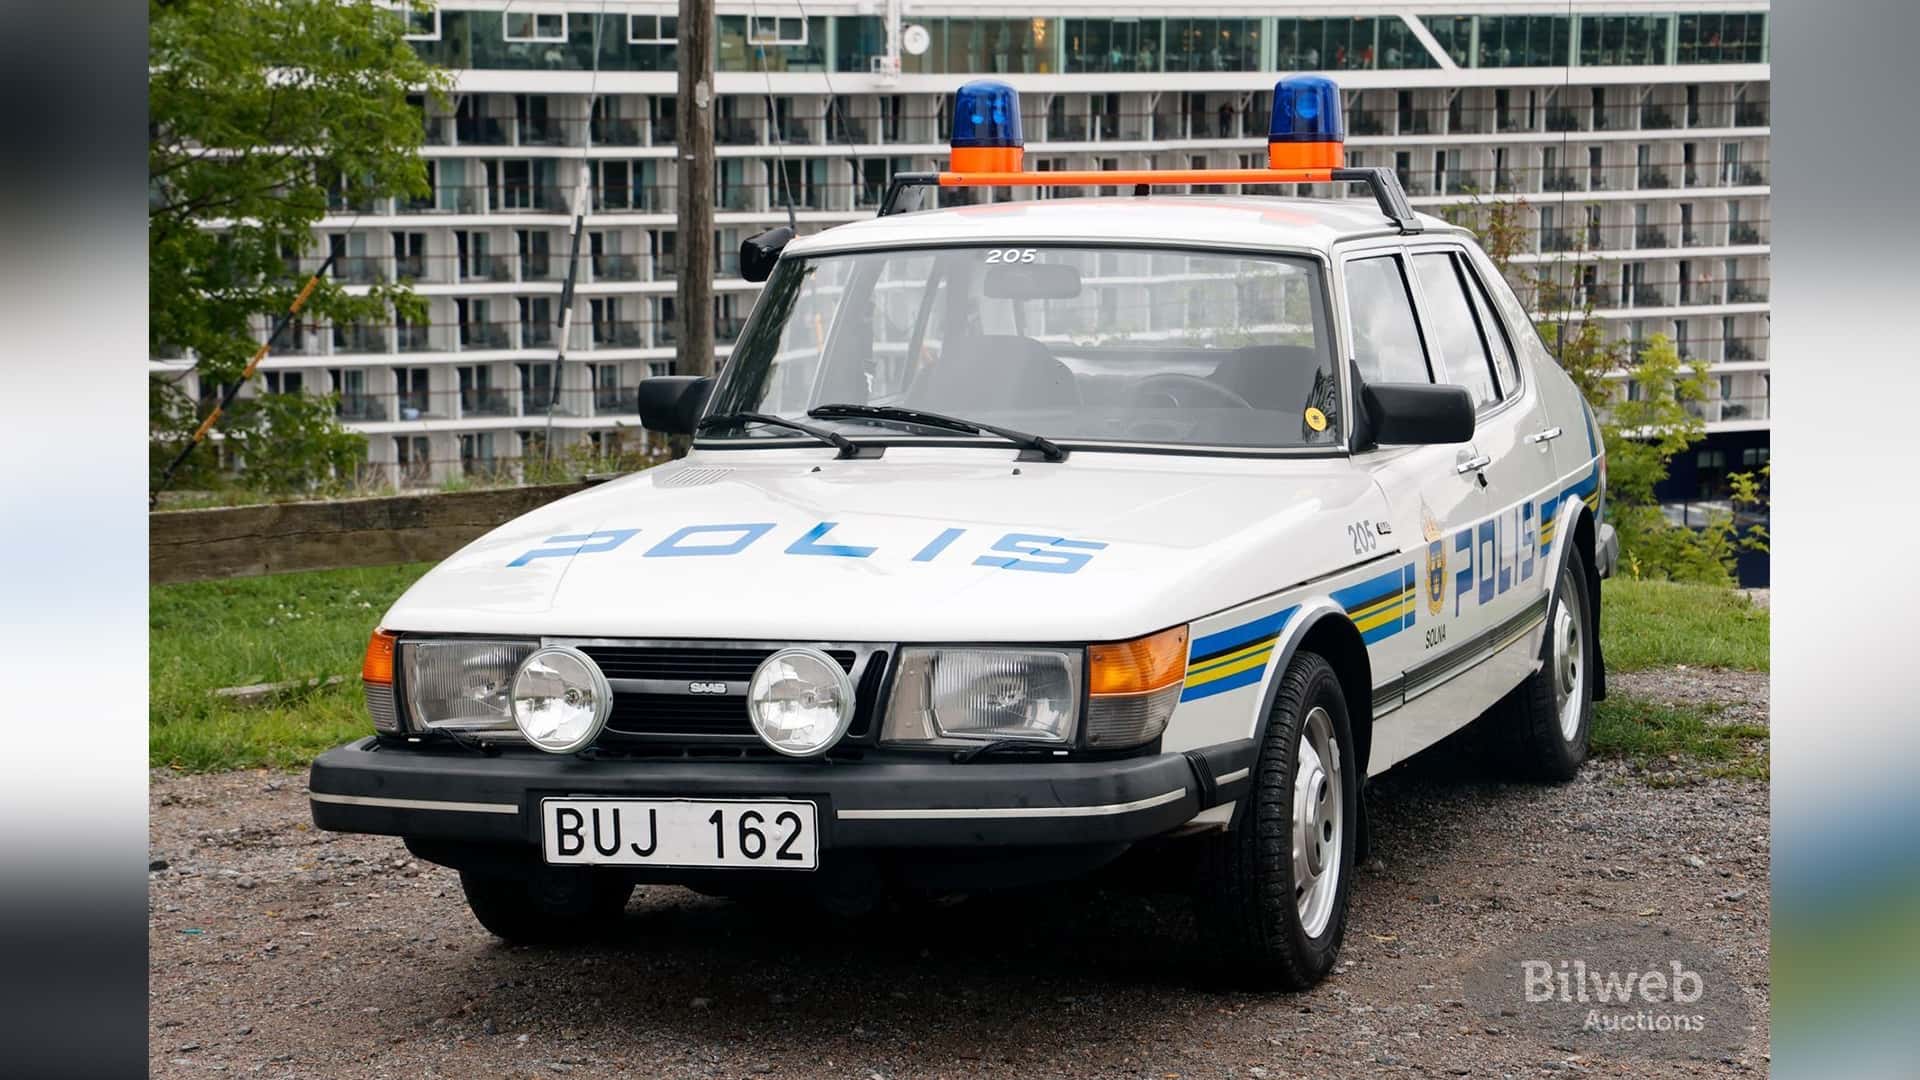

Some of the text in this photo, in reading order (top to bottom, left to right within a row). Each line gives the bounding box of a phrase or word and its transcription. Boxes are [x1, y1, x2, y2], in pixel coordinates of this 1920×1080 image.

[985, 248, 1037, 263] 205
[506, 522, 1109, 574] POLIS
[1348, 520, 1376, 555] 205
[1455, 500, 1535, 618] POLIS
[1425, 624, 1446, 649] SOLNA
[556, 808, 804, 861] BUJ 162
